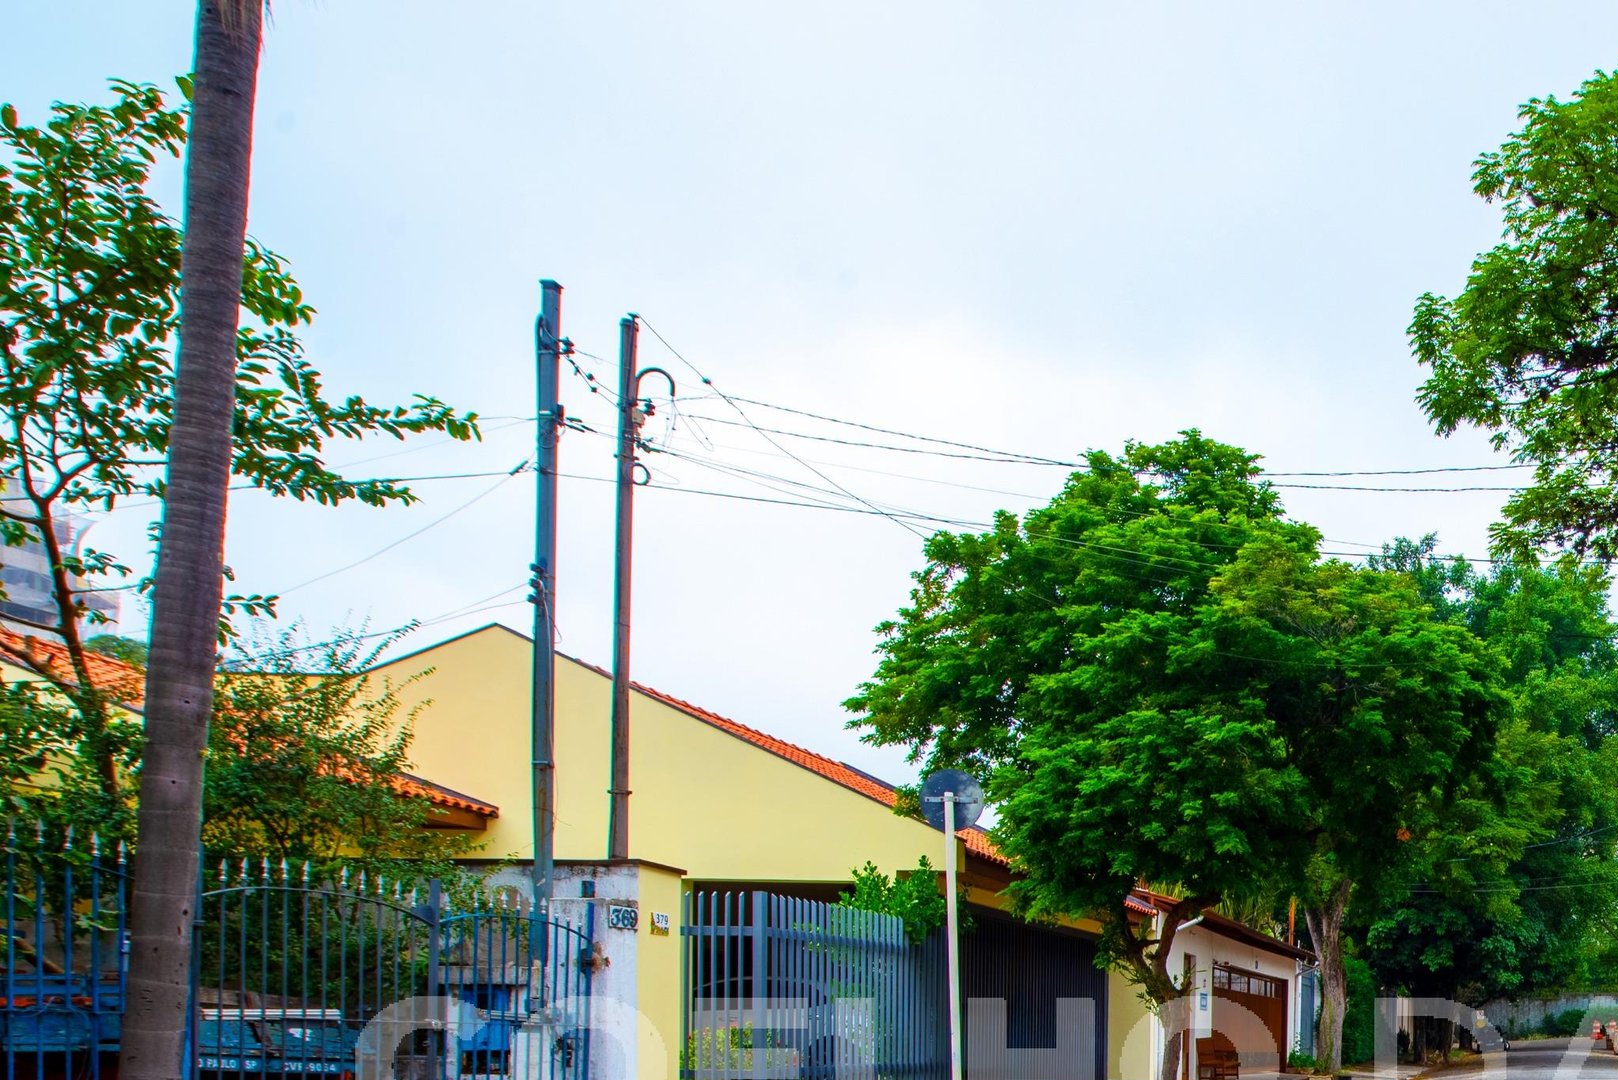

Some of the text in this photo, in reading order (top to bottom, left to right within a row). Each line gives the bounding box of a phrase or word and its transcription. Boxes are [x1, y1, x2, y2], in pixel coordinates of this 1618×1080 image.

[610, 908, 638, 928] 369
[655, 913, 668, 926] 379
[245, 1060, 258, 1070] SP
